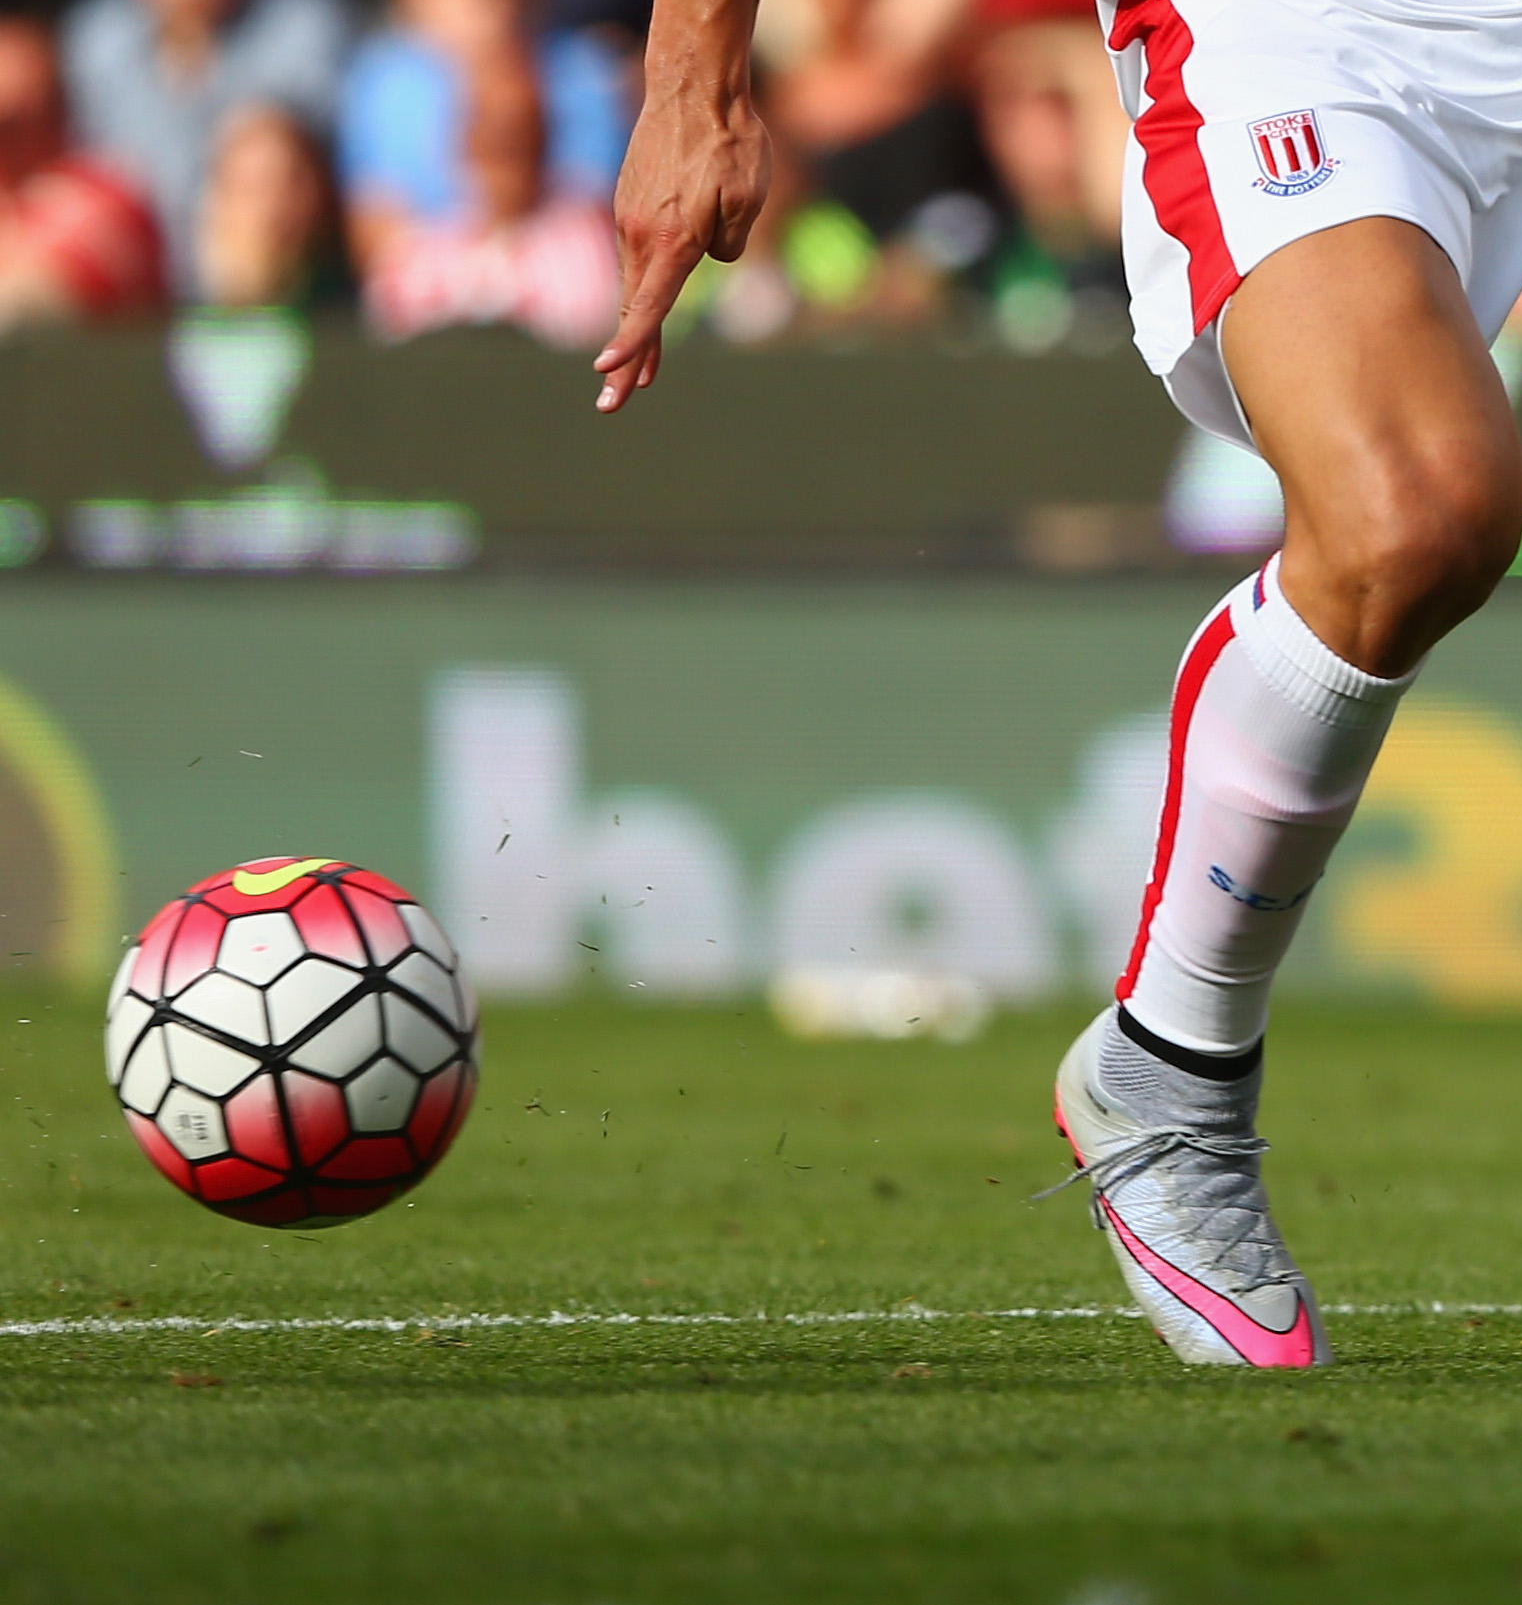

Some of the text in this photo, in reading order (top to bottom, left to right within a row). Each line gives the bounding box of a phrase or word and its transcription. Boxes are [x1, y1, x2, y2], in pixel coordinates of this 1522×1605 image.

[1253, 113, 1313, 136] STOKE
[1269, 125, 1299, 138] CITY
[1266, 182, 1287, 195] THE
